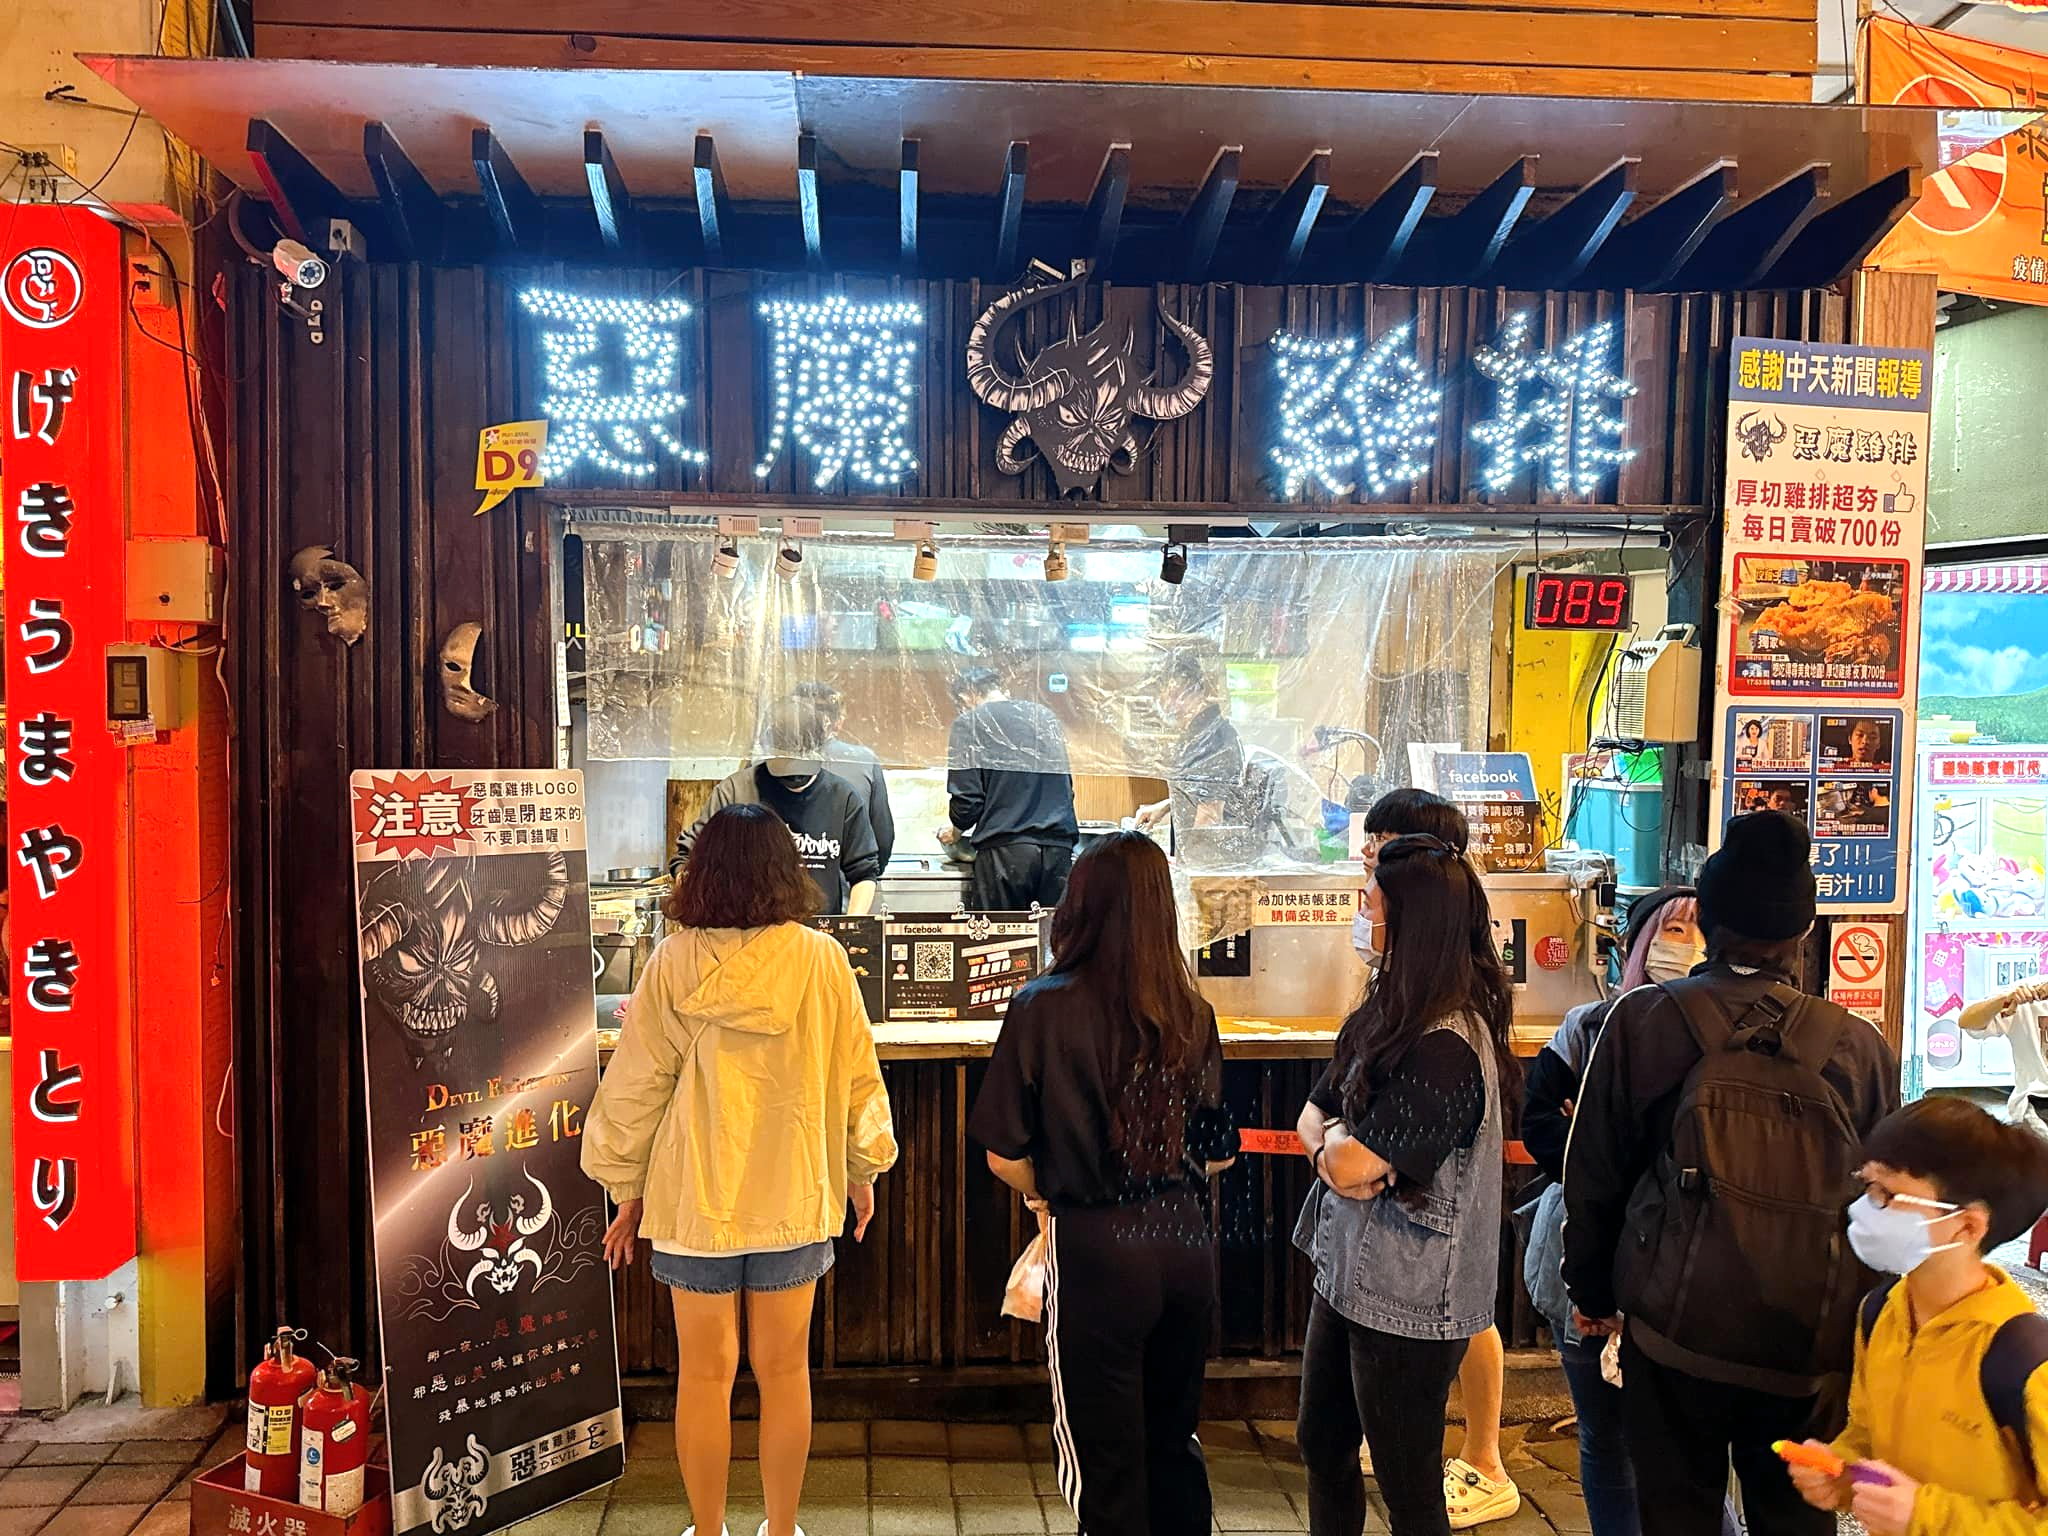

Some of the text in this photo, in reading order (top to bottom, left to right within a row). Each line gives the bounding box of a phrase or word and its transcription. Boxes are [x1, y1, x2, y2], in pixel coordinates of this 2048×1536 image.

[2012, 255, 2048, 284] 疫情
[1738, 349, 1923, 399] 感謝中天新聞報導
[1792, 424, 1918, 465] 惡魔雞排
[484, 449, 539, 482] D9
[1735, 479, 1879, 513] 厚切雞排超夯
[1742, 514, 1902, 547] 每日賣破700份
[1535, 579, 1626, 625] 089
[473, 782, 578, 798] 惡魔雞排LOGO
[1448, 769, 1519, 784] facebook
[11, 366, 84, 1231] げきうまやきとり
[368, 791, 464, 839] 注意
[471, 804, 582, 826] 牙齒是閉起來的
[1468, 843, 1532, 855] 取統一發票)
[1258, 893, 1352, 906] 為加快結帳速度
[1271, 909, 1338, 922] 請備妥現金
[904, 924, 943, 935] facebook
[409, 1100, 582, 1171] 惡魔進化
[540, 1449, 580, 1471] DEVIL
[228, 1503, 308, 1536] 滅火器
